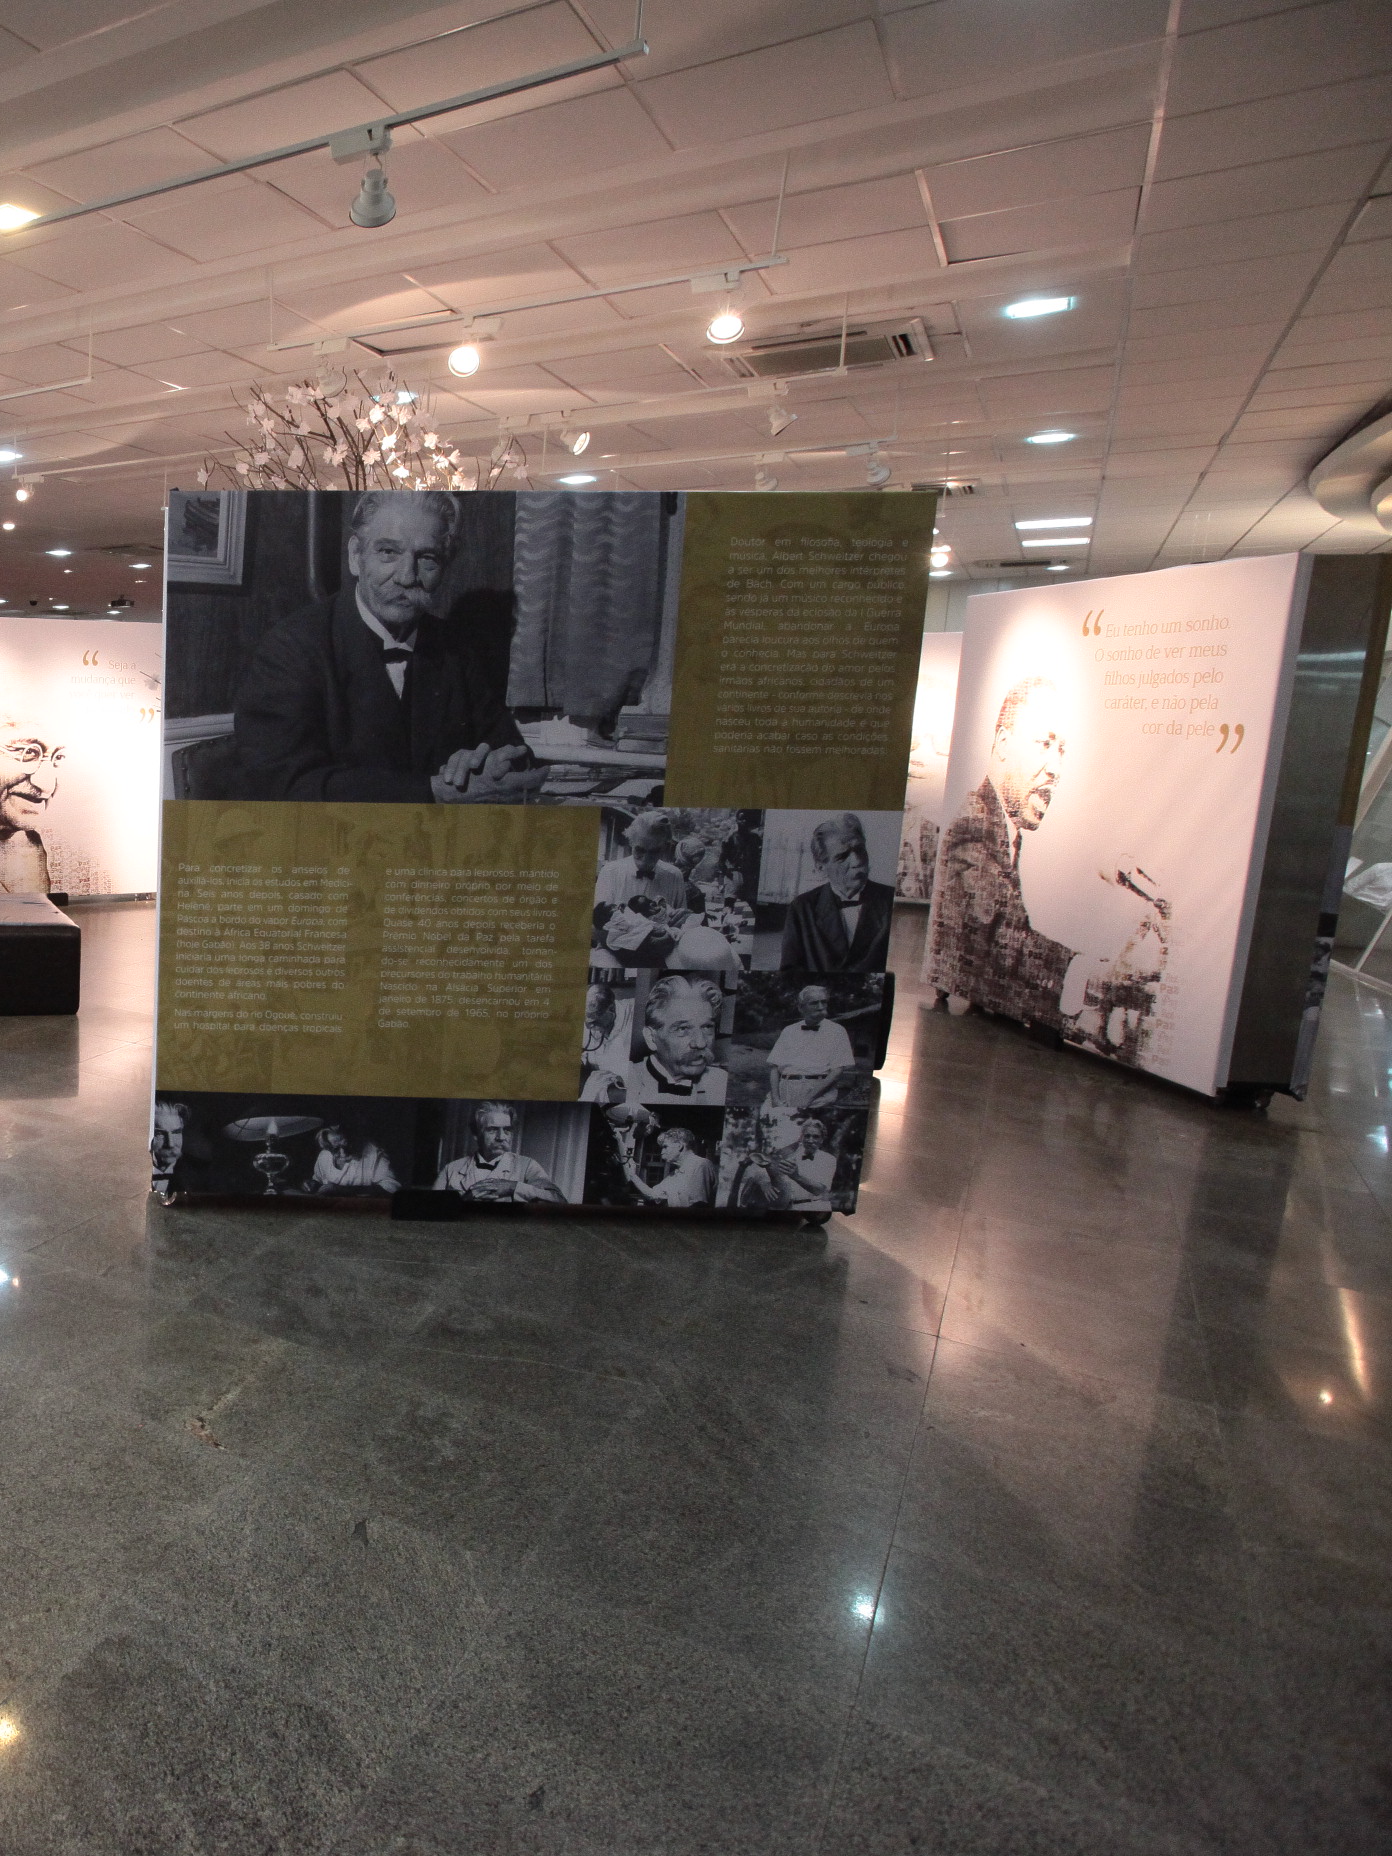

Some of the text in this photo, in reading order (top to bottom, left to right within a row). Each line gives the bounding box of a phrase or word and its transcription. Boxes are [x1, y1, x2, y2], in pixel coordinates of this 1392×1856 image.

[772, 552, 804, 561] Albert
[808, 552, 864, 561] Schweitzer
[868, 552, 907, 563] chegou
[777, 621, 834, 630] abandonar
[864, 622, 900, 633] Europa
[1105, 615, 1231, 638] Eu tenho um sonho.
[787, 649, 807, 658] Mas
[812, 651, 836, 660] para
[842, 649, 897, 658] Schweitzer
[1095, 644, 1227, 662] O sonho de ver meus
[109, 660, 128, 672] Seja
[868, 663, 895, 675] pelos
[71, 675, 136, 687] mudança que
[1104, 668, 1223, 688] filhos julgados pelo
[1104, 694, 1218, 714] caráter, e não pela
[1142, 720, 1215, 739] cor da pele
[786, 744, 822, 754] fossem
[178, 863, 200, 872] Para
[209, 863, 262, 873] concretizar
[291, 865, 328, 874] anseios
[337, 865, 351, 874] de
[197, 889, 216, 898] Seis
[288, 890, 322, 899] casado
[451, 894, 499, 903] concertos
[502, 894, 515, 904] de
[383, 918, 414, 929] Quase
[418, 918, 431, 927] 40
[463, 919, 496, 930] depois
[500, 920, 545, 929] receberia
[177, 927, 211, 936] destino
[254, 928, 301, 939] Equatorial
[304, 929, 347, 938] Francesa
[423, 931, 451, 940] Nobel
[476, 932, 493, 941] Paz
[499, 932, 520, 943] pela
[526, 933, 555, 942] tarefa
[239, 940, 256, 949] Aos
[259, 941, 270, 950] 38
[296, 941, 346, 951] Schweitzer
[382, 944, 436, 953] assistencial
[238, 953, 265, 964] longa
[268, 954, 320, 963] caminhada
[324, 957, 346, 966] para
[415, 958, 505, 967] reconhecidamente
[535, 959, 553, 968] dos
[380, 971, 436, 980] precursores
[438, 970, 450, 979] do
[452, 970, 493, 979] trabalho
[175, 977, 213, 987] doentes
[218, 978, 231, 987] de
[266, 979, 288, 988] mais
[293, 979, 327, 990] pobres
[331, 980, 345, 989] do
[380, 981, 418, 991] Nascido
[487, 983, 528, 994] Superior
[378, 1006, 391, 1015] de
[396, 1007, 442, 1016] setembro
[446, 1007, 460, 1017] de
[193, 1021, 230, 1032] hospital
[234, 1024, 255, 1033] para
[302, 1023, 342, 1034] tropicais
